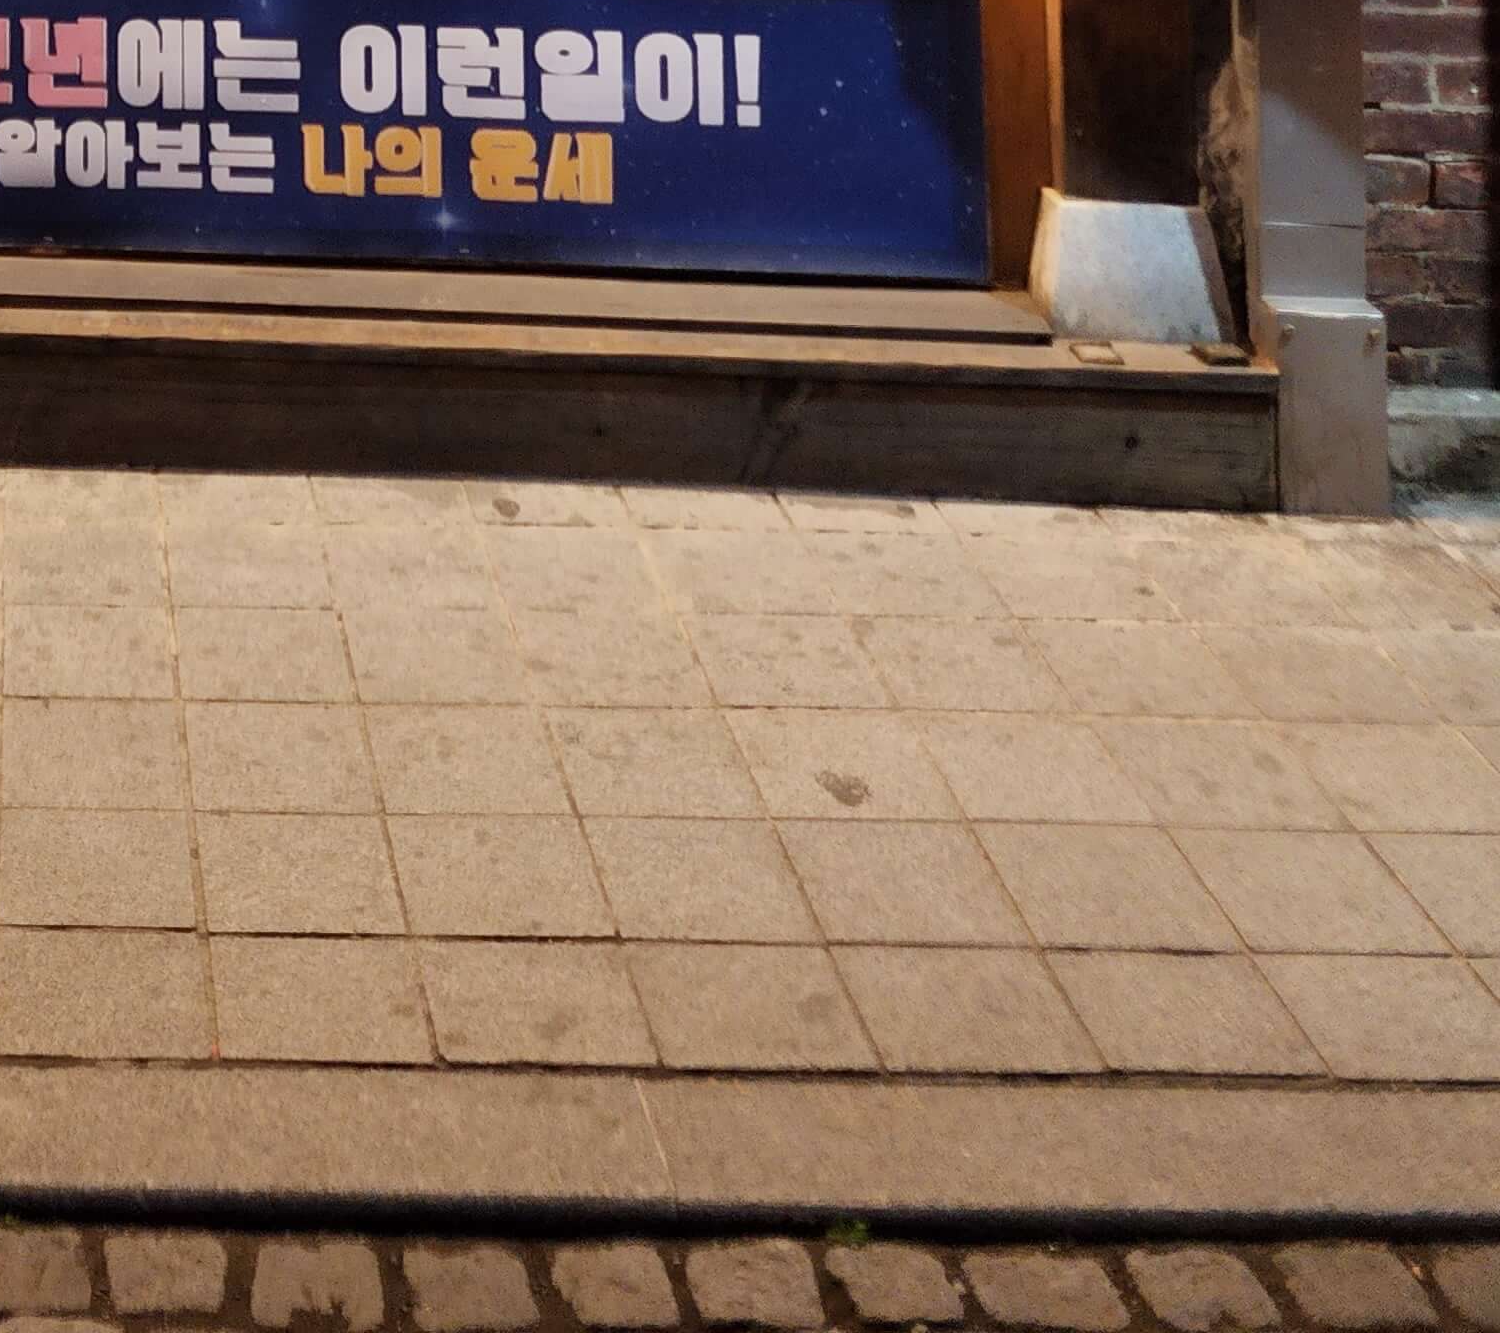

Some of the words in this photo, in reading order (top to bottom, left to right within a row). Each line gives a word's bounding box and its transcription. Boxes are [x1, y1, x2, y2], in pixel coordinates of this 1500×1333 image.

[338, 23, 763, 127] 이런일이!
[302, 124, 443, 199] 나의
[469, 129, 615, 206] 운세
